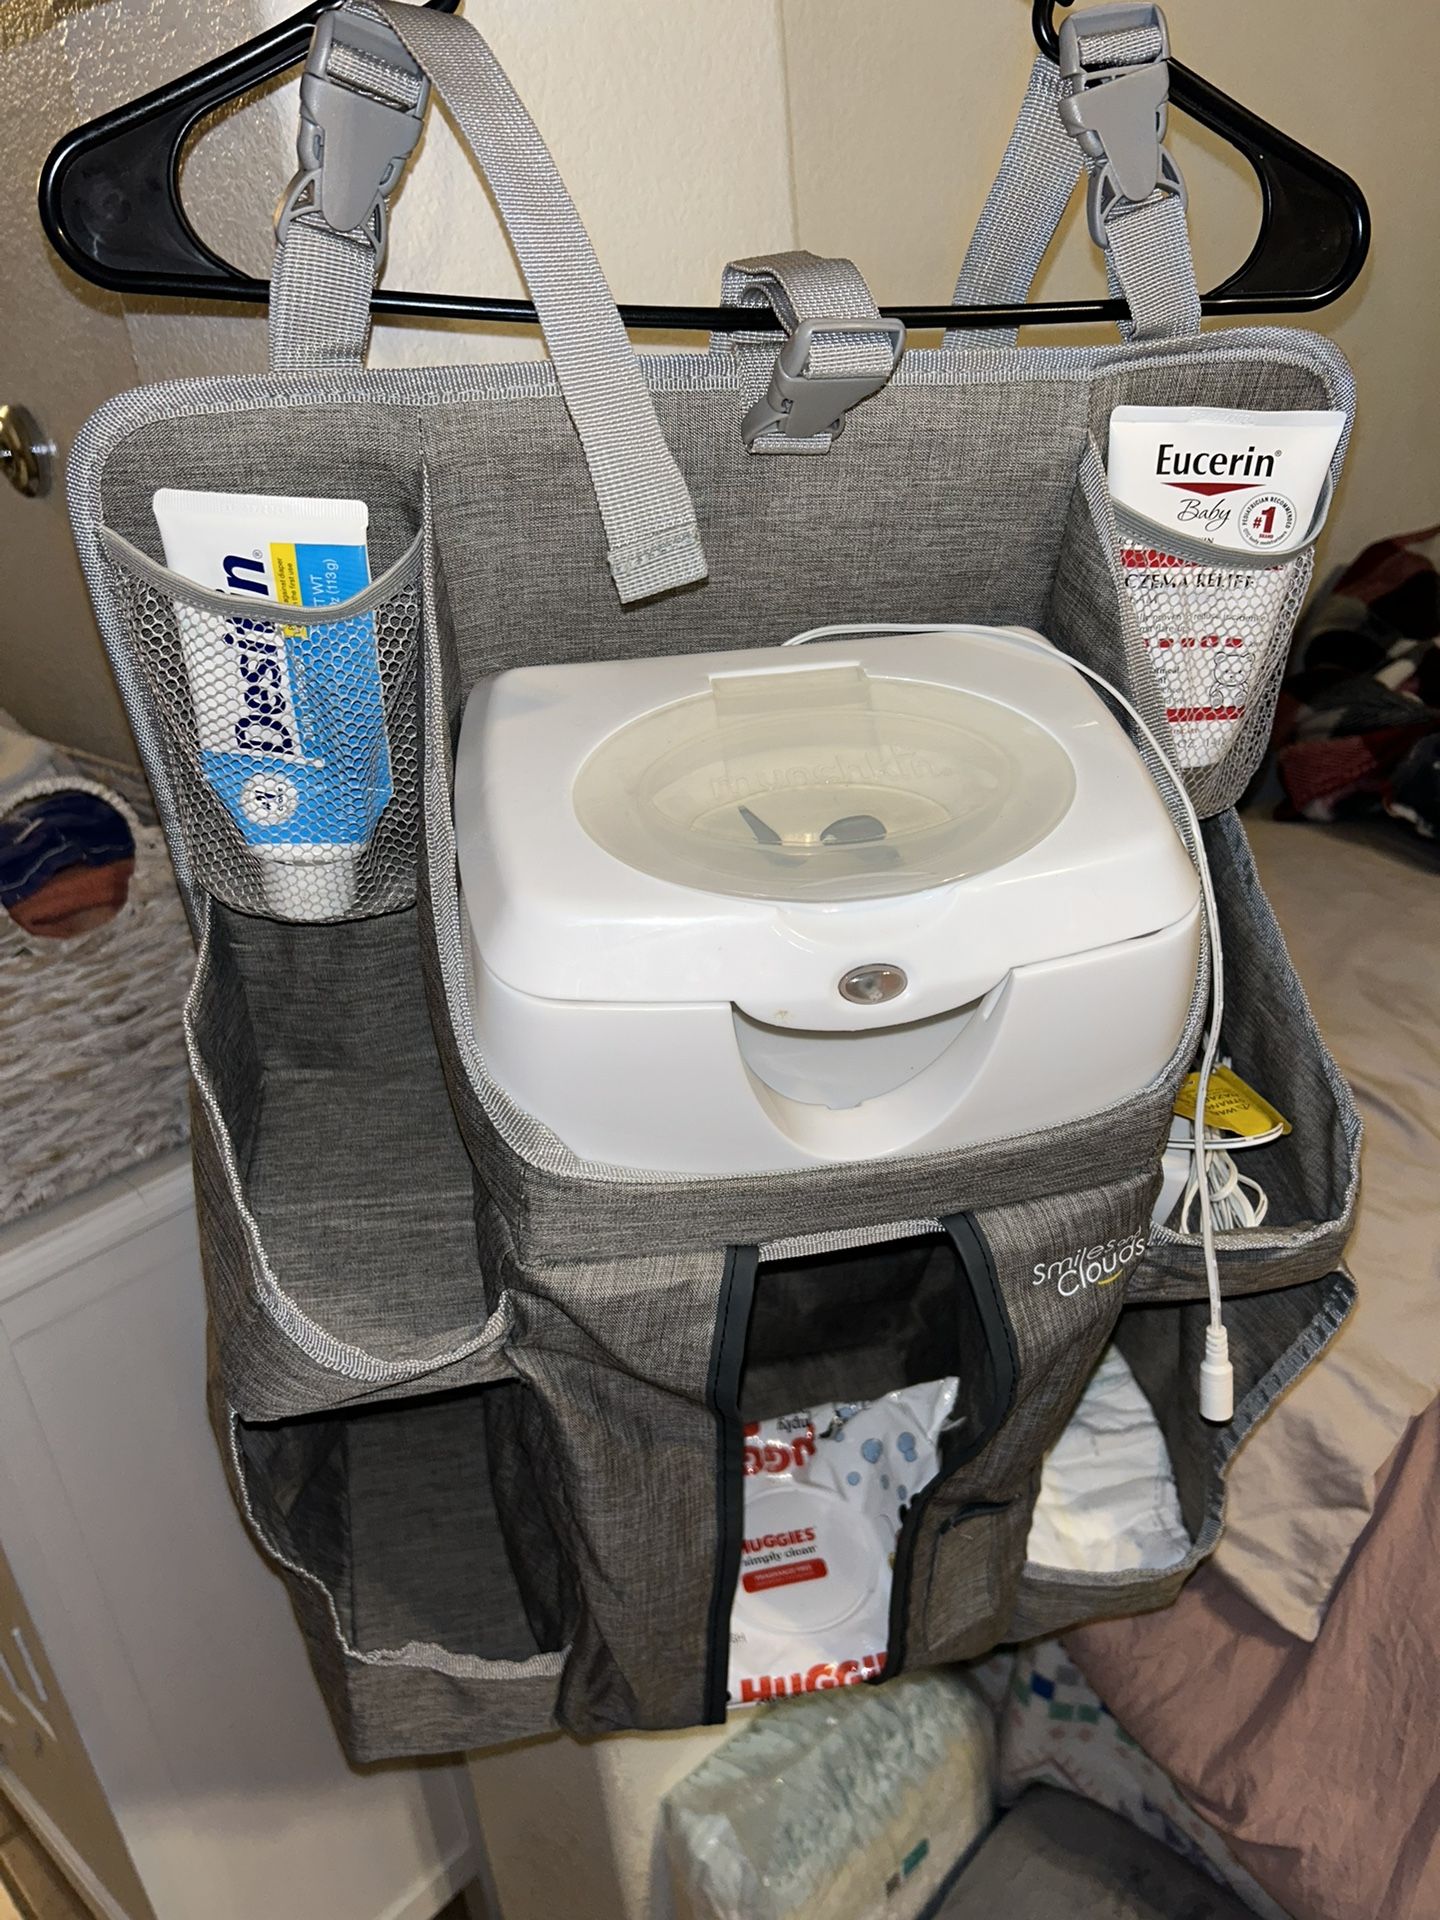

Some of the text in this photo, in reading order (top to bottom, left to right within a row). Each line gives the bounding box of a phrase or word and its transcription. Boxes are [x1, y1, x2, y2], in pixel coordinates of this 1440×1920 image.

[1156, 443, 1275, 478] Eucerin
[1177, 498, 1231, 532] Baby
[1253, 506, 1276, 534] #1
[310, 574, 325, 595] WT
